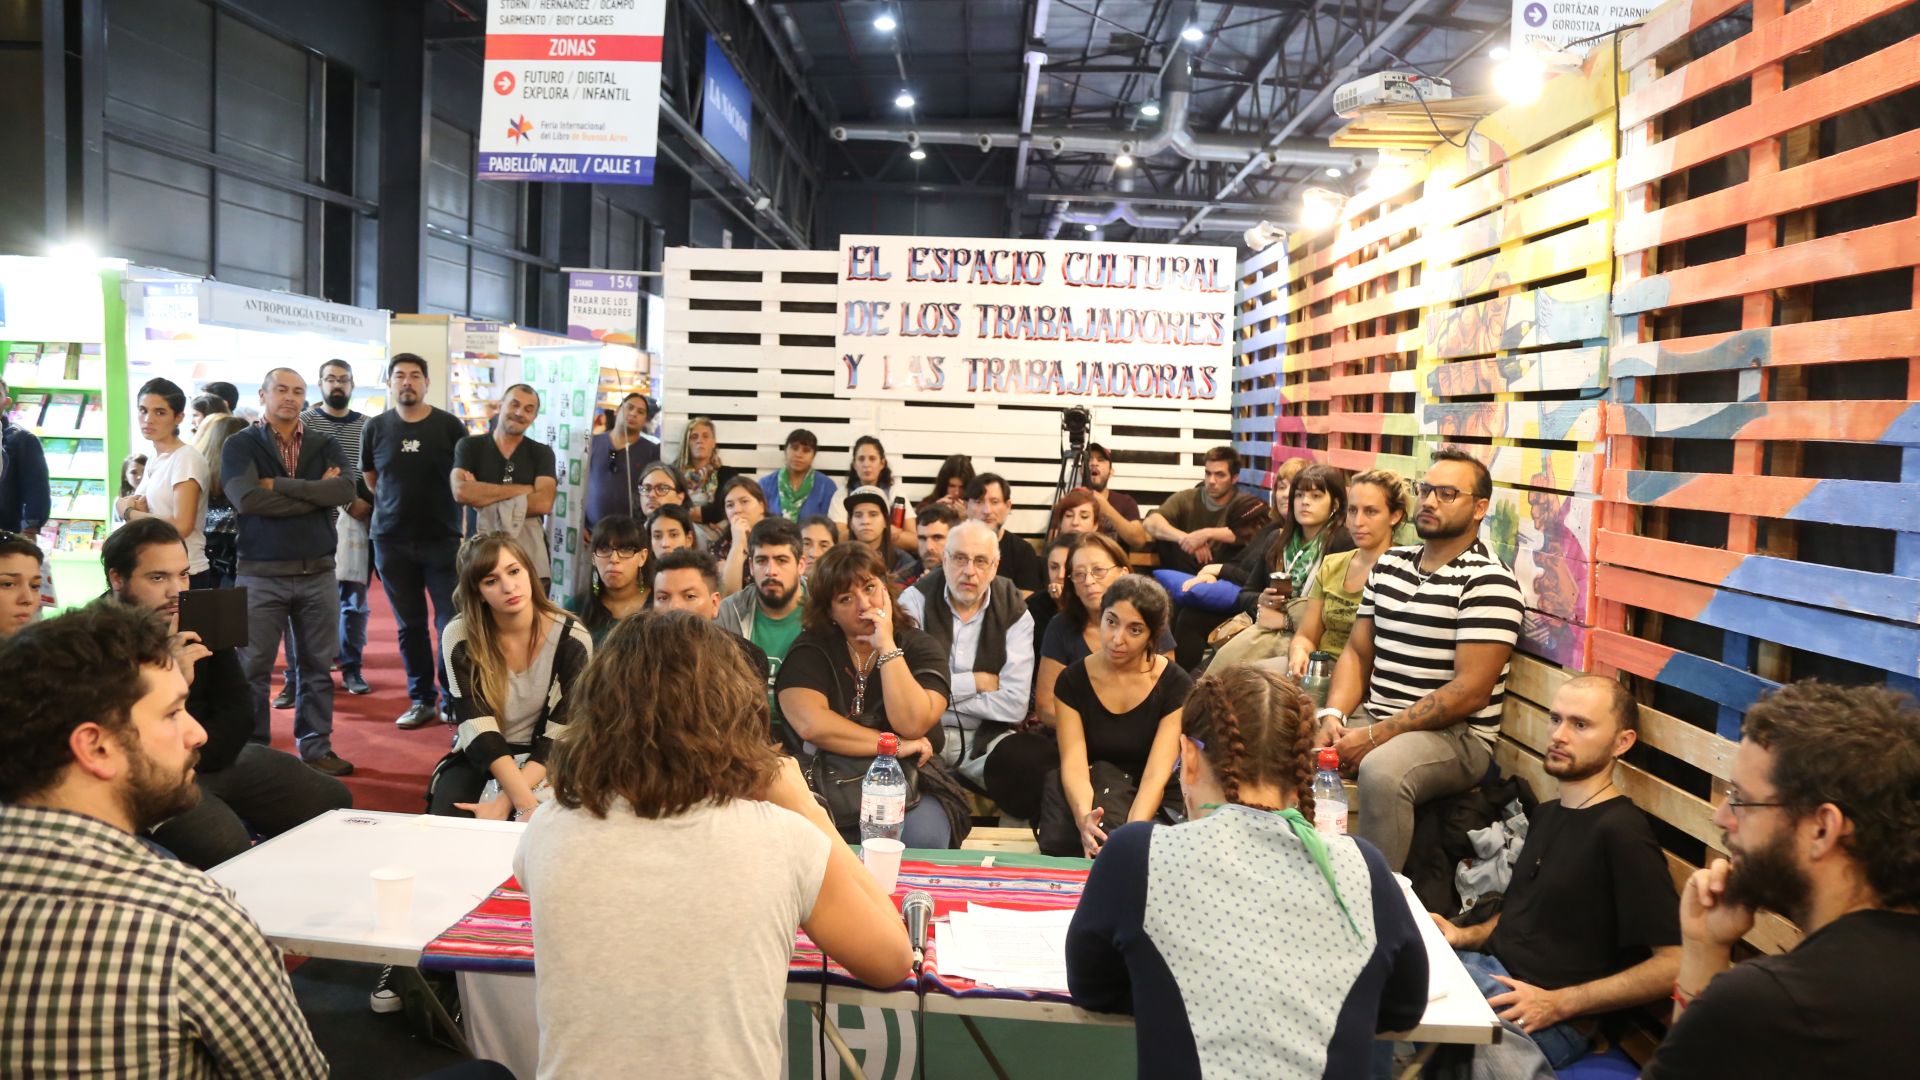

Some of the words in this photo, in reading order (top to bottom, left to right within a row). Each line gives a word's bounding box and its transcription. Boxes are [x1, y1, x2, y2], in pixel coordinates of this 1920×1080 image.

[600, 0, 635, 10] OCAMPO
[1553, 1, 1600, 16] CORTÁZAR
[499, 15, 546, 26] SARMIENTO
[556, 16, 574, 26] BIOY
[577, 16, 614, 26] CASARES
[1552, 19, 1601, 32] GOROSTIZA
[548, 38, 597, 57] ZONAS
[524, 70, 565, 84] FUTURO
[577, 71, 617, 85] DIGITAL
[523, 86, 570, 100] EXPLORA
[582, 87, 632, 101] INFANTIL
[540, 120, 559, 130] Feria
[560, 121, 606, 131] Internacional
[552, 132, 570, 141] Libro
[488, 153, 547, 173] PABELLÓN
[549, 158, 580, 174] AZUL
[593, 158, 631, 174] CALLE
[633, 159, 641, 174] 1
[846, 245, 892, 283] EL
[906, 247, 1046, 286] ESPACIO
[1061, 251, 1231, 294] CULTURAL
[609, 275, 633, 289] 154
[573, 295, 599, 305] RADAR
[601, 296, 613, 306] DE
[614, 297, 628, 307] LOS
[573, 305, 633, 317] TRABAJADORES
[842, 301, 892, 338] DE
[899, 301, 962, 338] LOS
[975, 303, 1227, 347] TRABAJADORES
[842, 353, 864, 390] Y
[961, 357, 1218, 401] TRABAJADORAS
